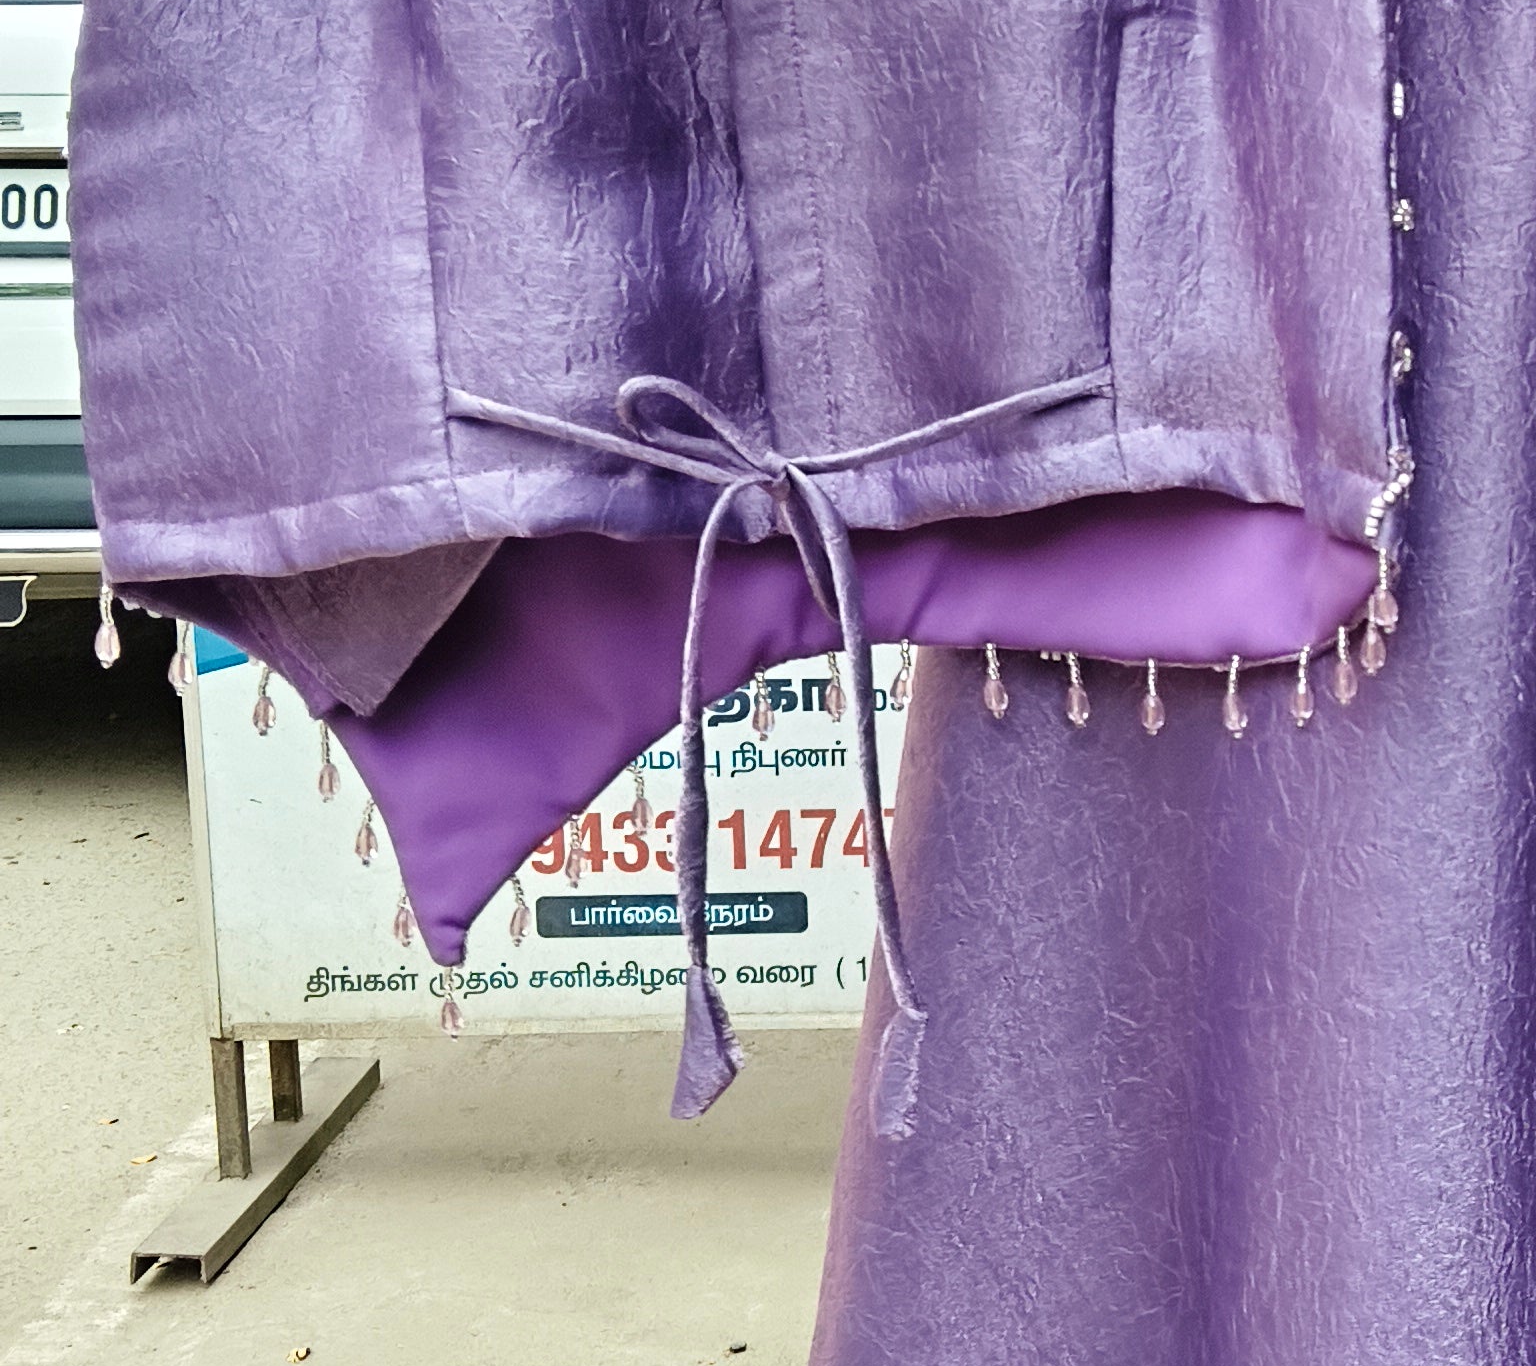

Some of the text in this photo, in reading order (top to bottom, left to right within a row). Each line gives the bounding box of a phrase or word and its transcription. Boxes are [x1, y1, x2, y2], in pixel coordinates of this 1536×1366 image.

[1, 183, 59, 230] 00
[730, 740, 848, 778] நிபுணர்
[303, 965, 419, 1003] திங்கள்
[735, 963, 817, 988] வரை
